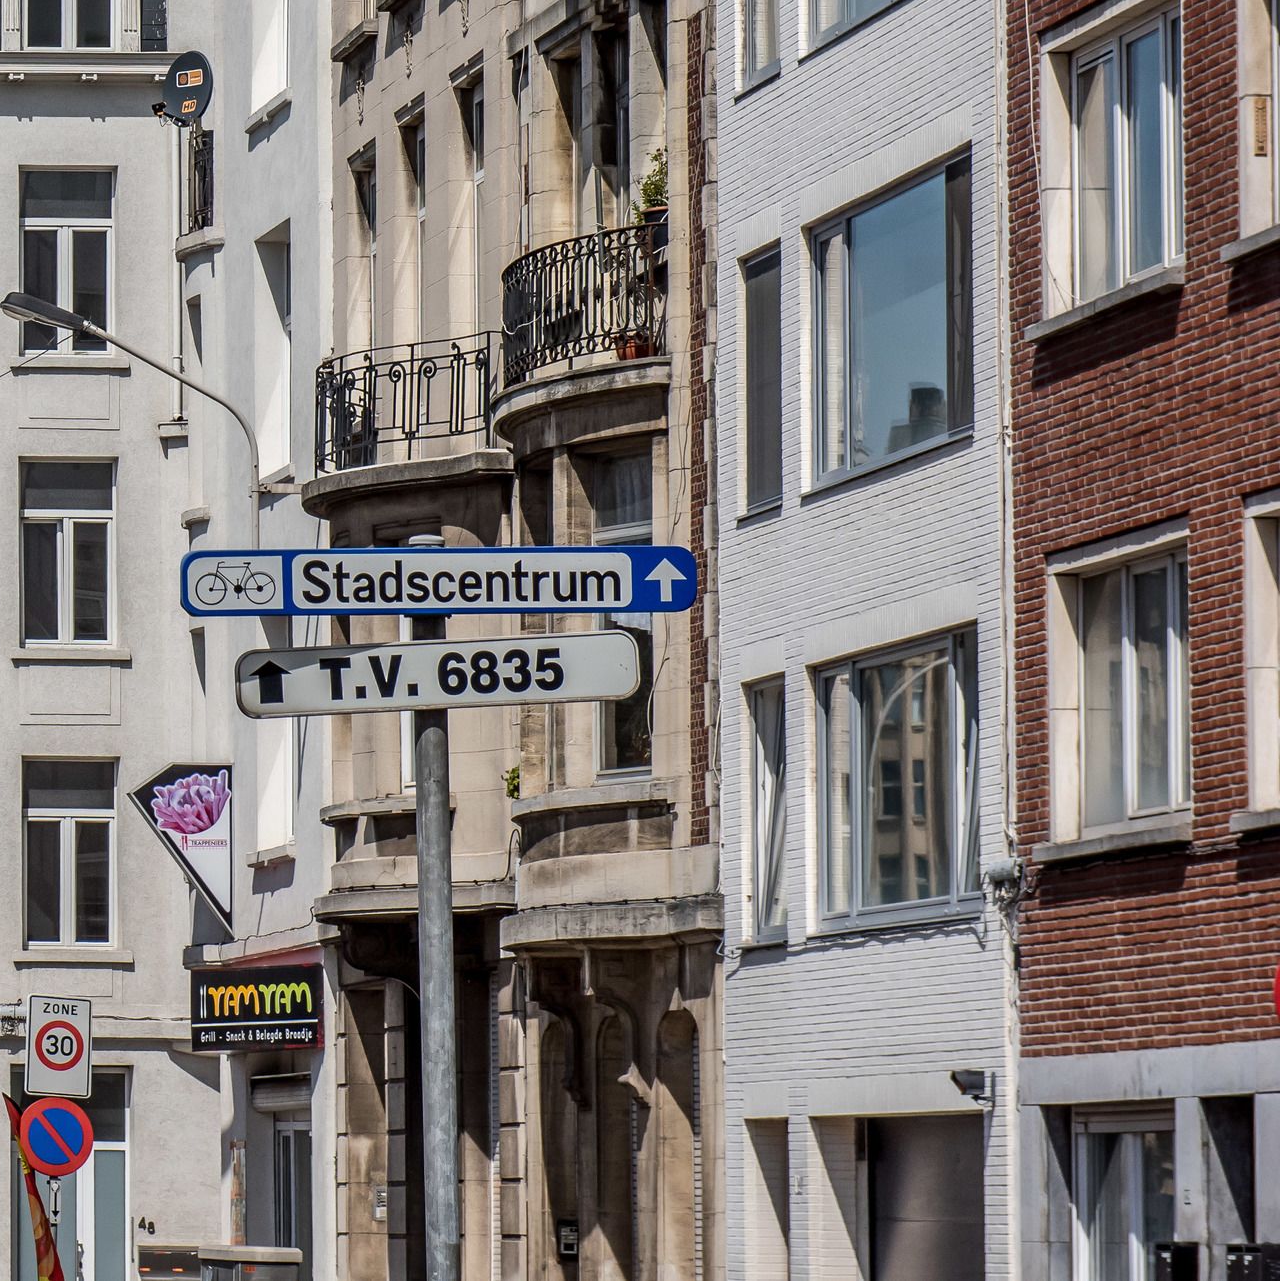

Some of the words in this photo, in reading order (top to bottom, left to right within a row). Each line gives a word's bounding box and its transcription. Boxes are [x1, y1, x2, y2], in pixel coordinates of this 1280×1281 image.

[301, 559, 623, 604] Stadscentrum
[319, 654, 420, 701] T.V.
[437, 647, 565, 696] 6835
[43, 1002, 78, 1016] ZONE
[45, 1034, 74, 1057] 30
[200, 1030, 216, 1043] Grill
[226, 1029, 246, 1042] Snack
[255, 1027, 283, 1043] Belegde
[138, 1216, 156, 1235] 48
